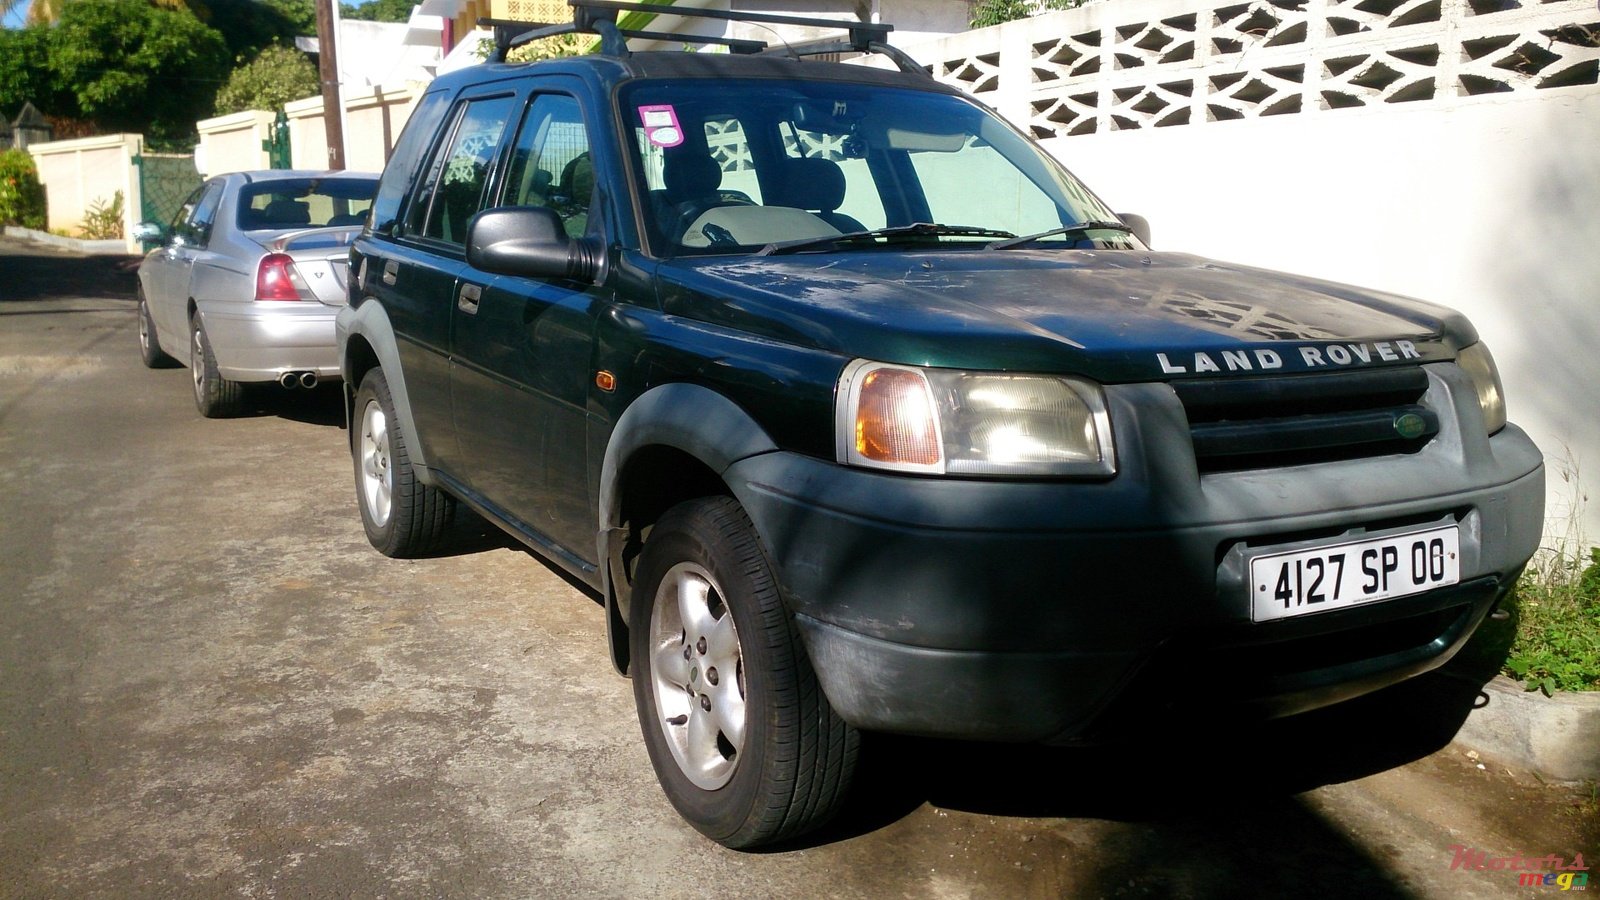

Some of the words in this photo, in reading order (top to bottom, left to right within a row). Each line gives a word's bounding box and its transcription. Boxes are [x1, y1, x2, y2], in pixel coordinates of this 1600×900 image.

[1156, 348, 1283, 374] LAND
[1298, 340, 1422, 367] ROVER
[1274, 553, 1346, 609] 4127
[1361, 545, 1398, 595] SP
